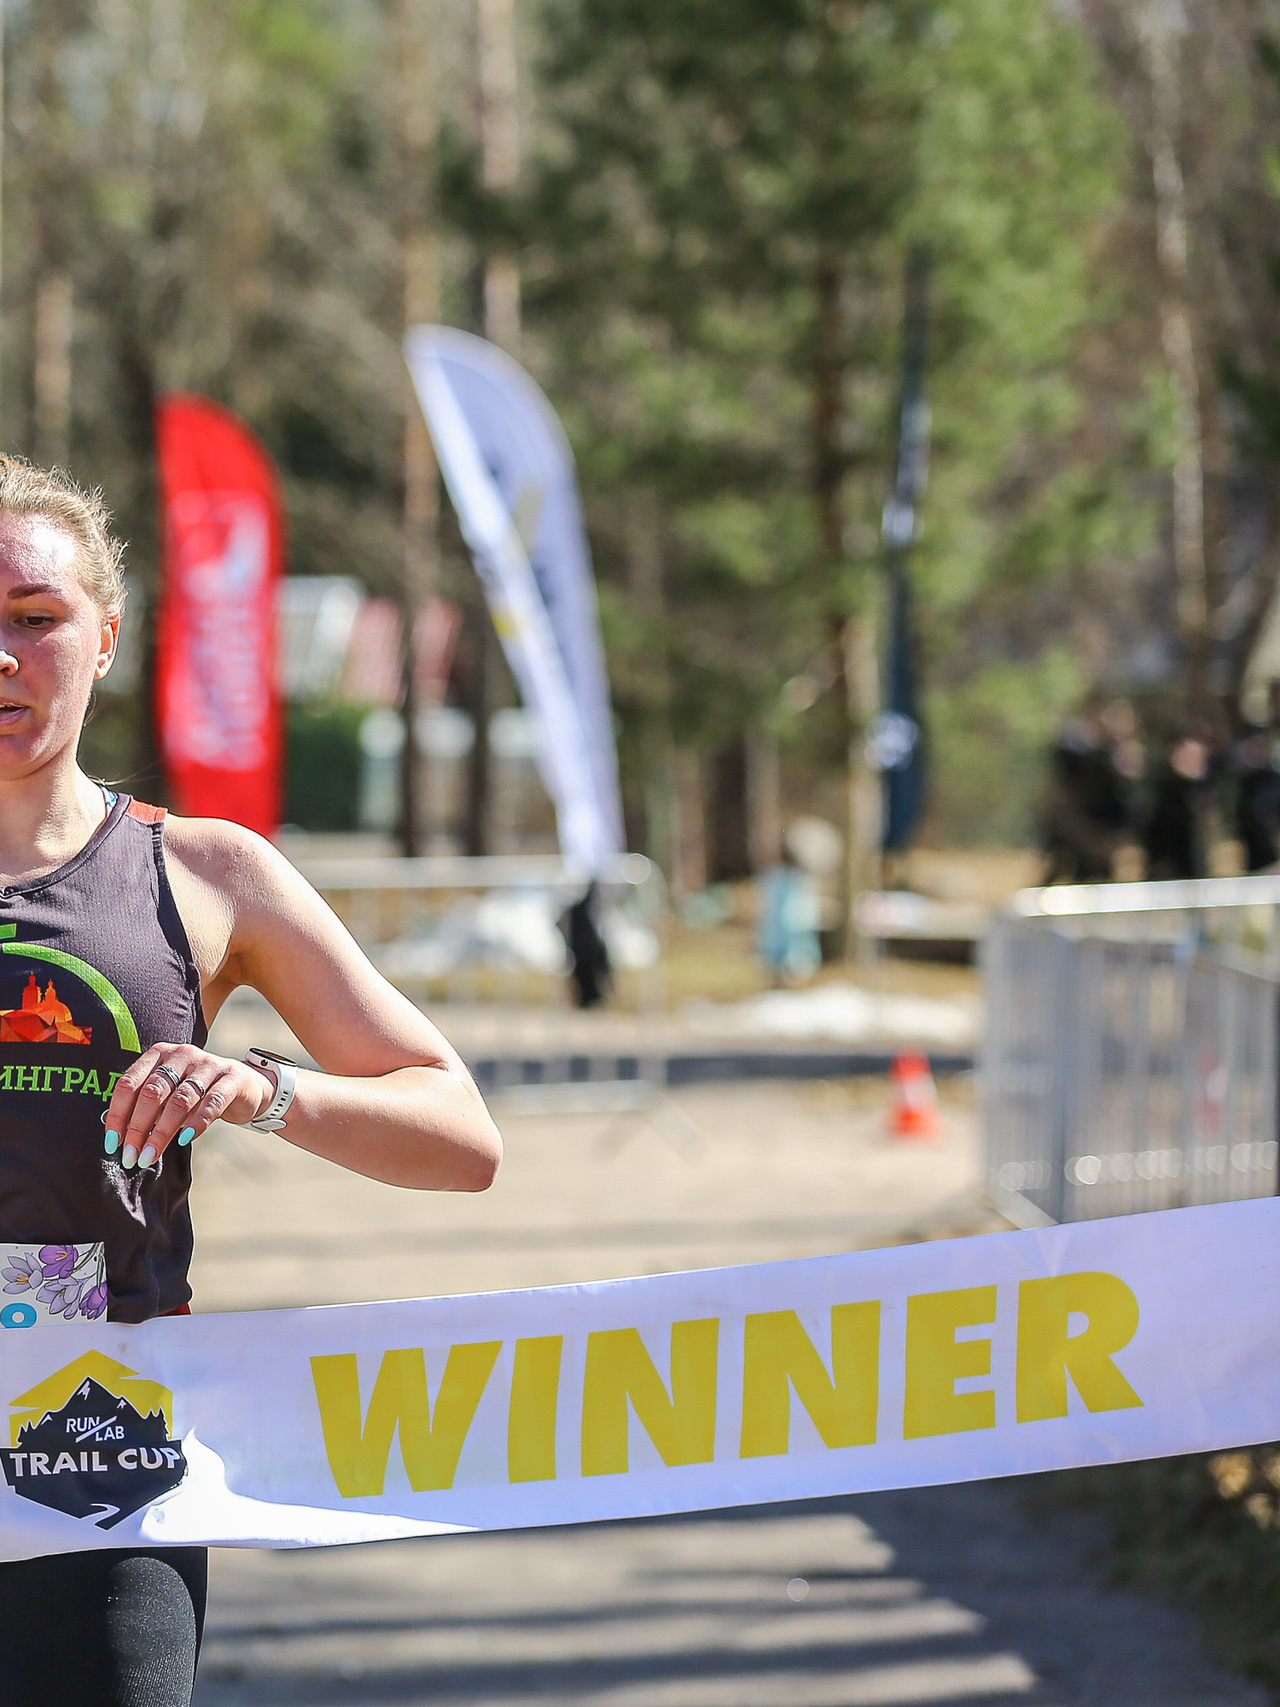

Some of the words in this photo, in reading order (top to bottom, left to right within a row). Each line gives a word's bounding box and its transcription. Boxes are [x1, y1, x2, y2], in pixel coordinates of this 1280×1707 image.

[309, 1270, 1145, 1498] WINNER
[66, 1416, 100, 1433] RUN
[95, 1426, 125, 1442] LAB
[9, 1451, 108, 1477] TRAIL
[117, 1447, 181, 1470] CUP
